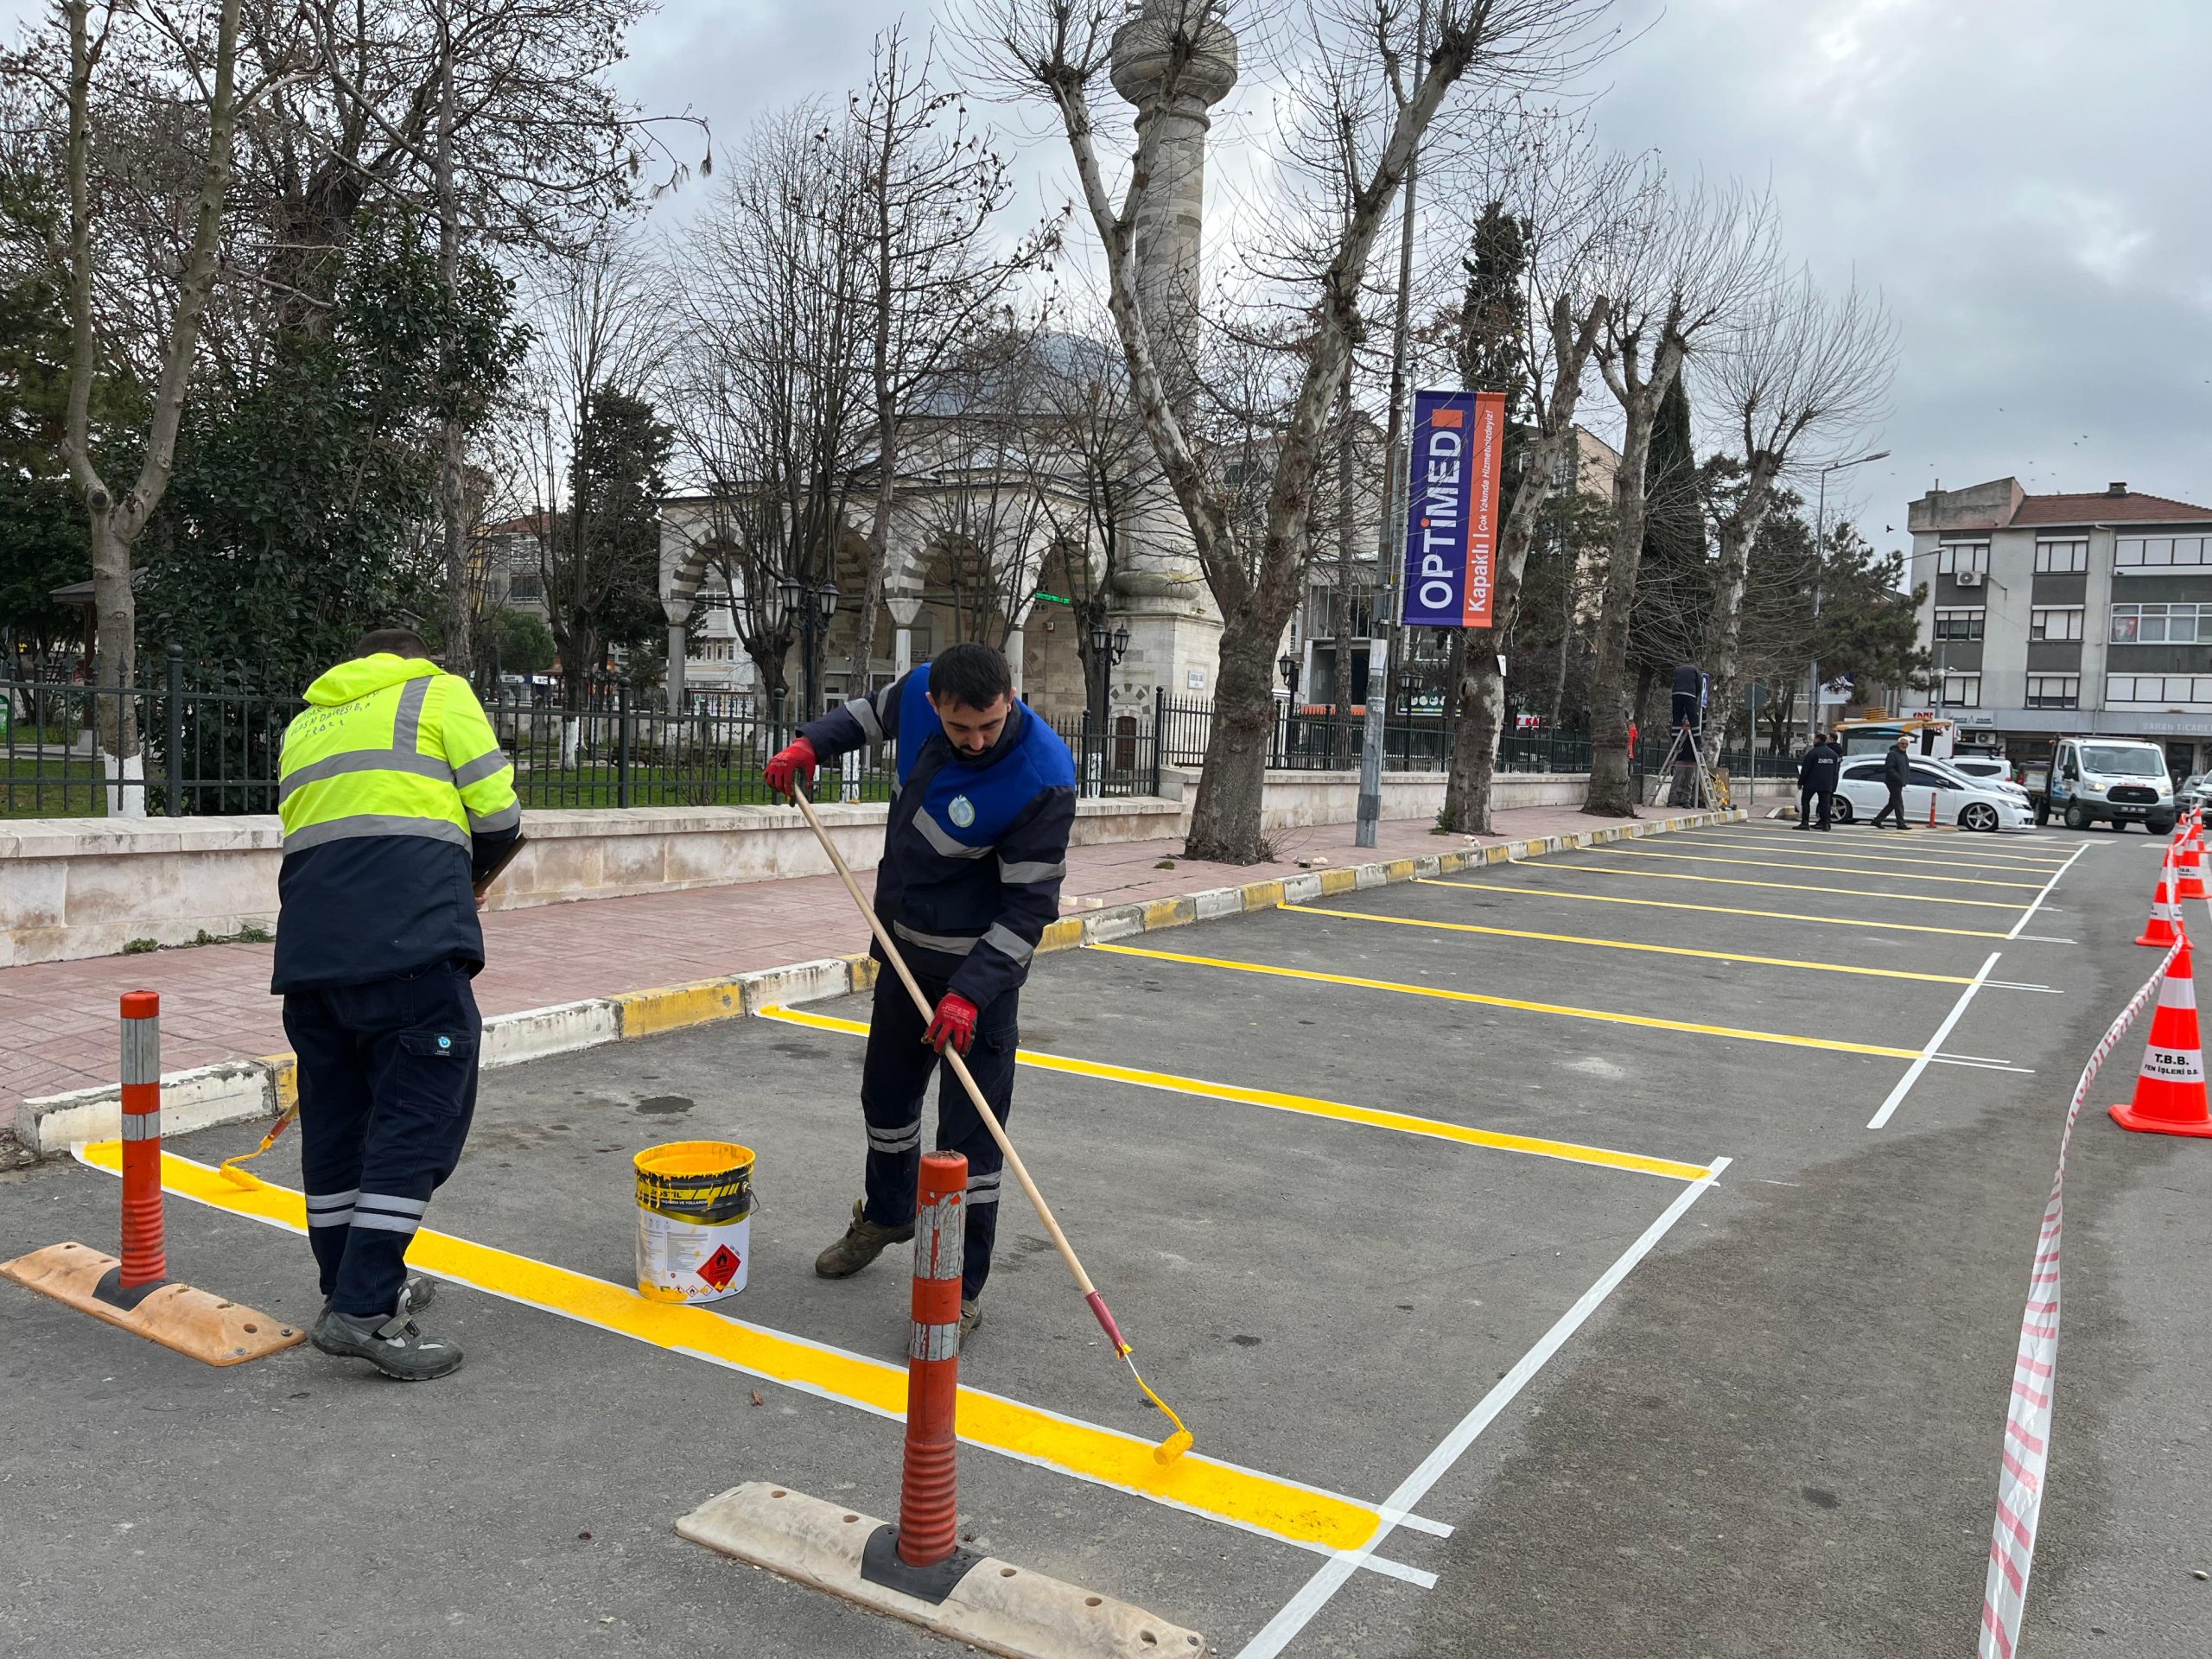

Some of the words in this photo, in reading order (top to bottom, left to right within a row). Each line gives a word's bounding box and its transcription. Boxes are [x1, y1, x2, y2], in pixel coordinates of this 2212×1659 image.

[1480, 480, 1490, 512] Yakında
[1478, 514, 1488, 531] Çok
[1468, 543, 1491, 612] Kapaklı
[2155, 1053, 2190, 1065] T.B.B.
